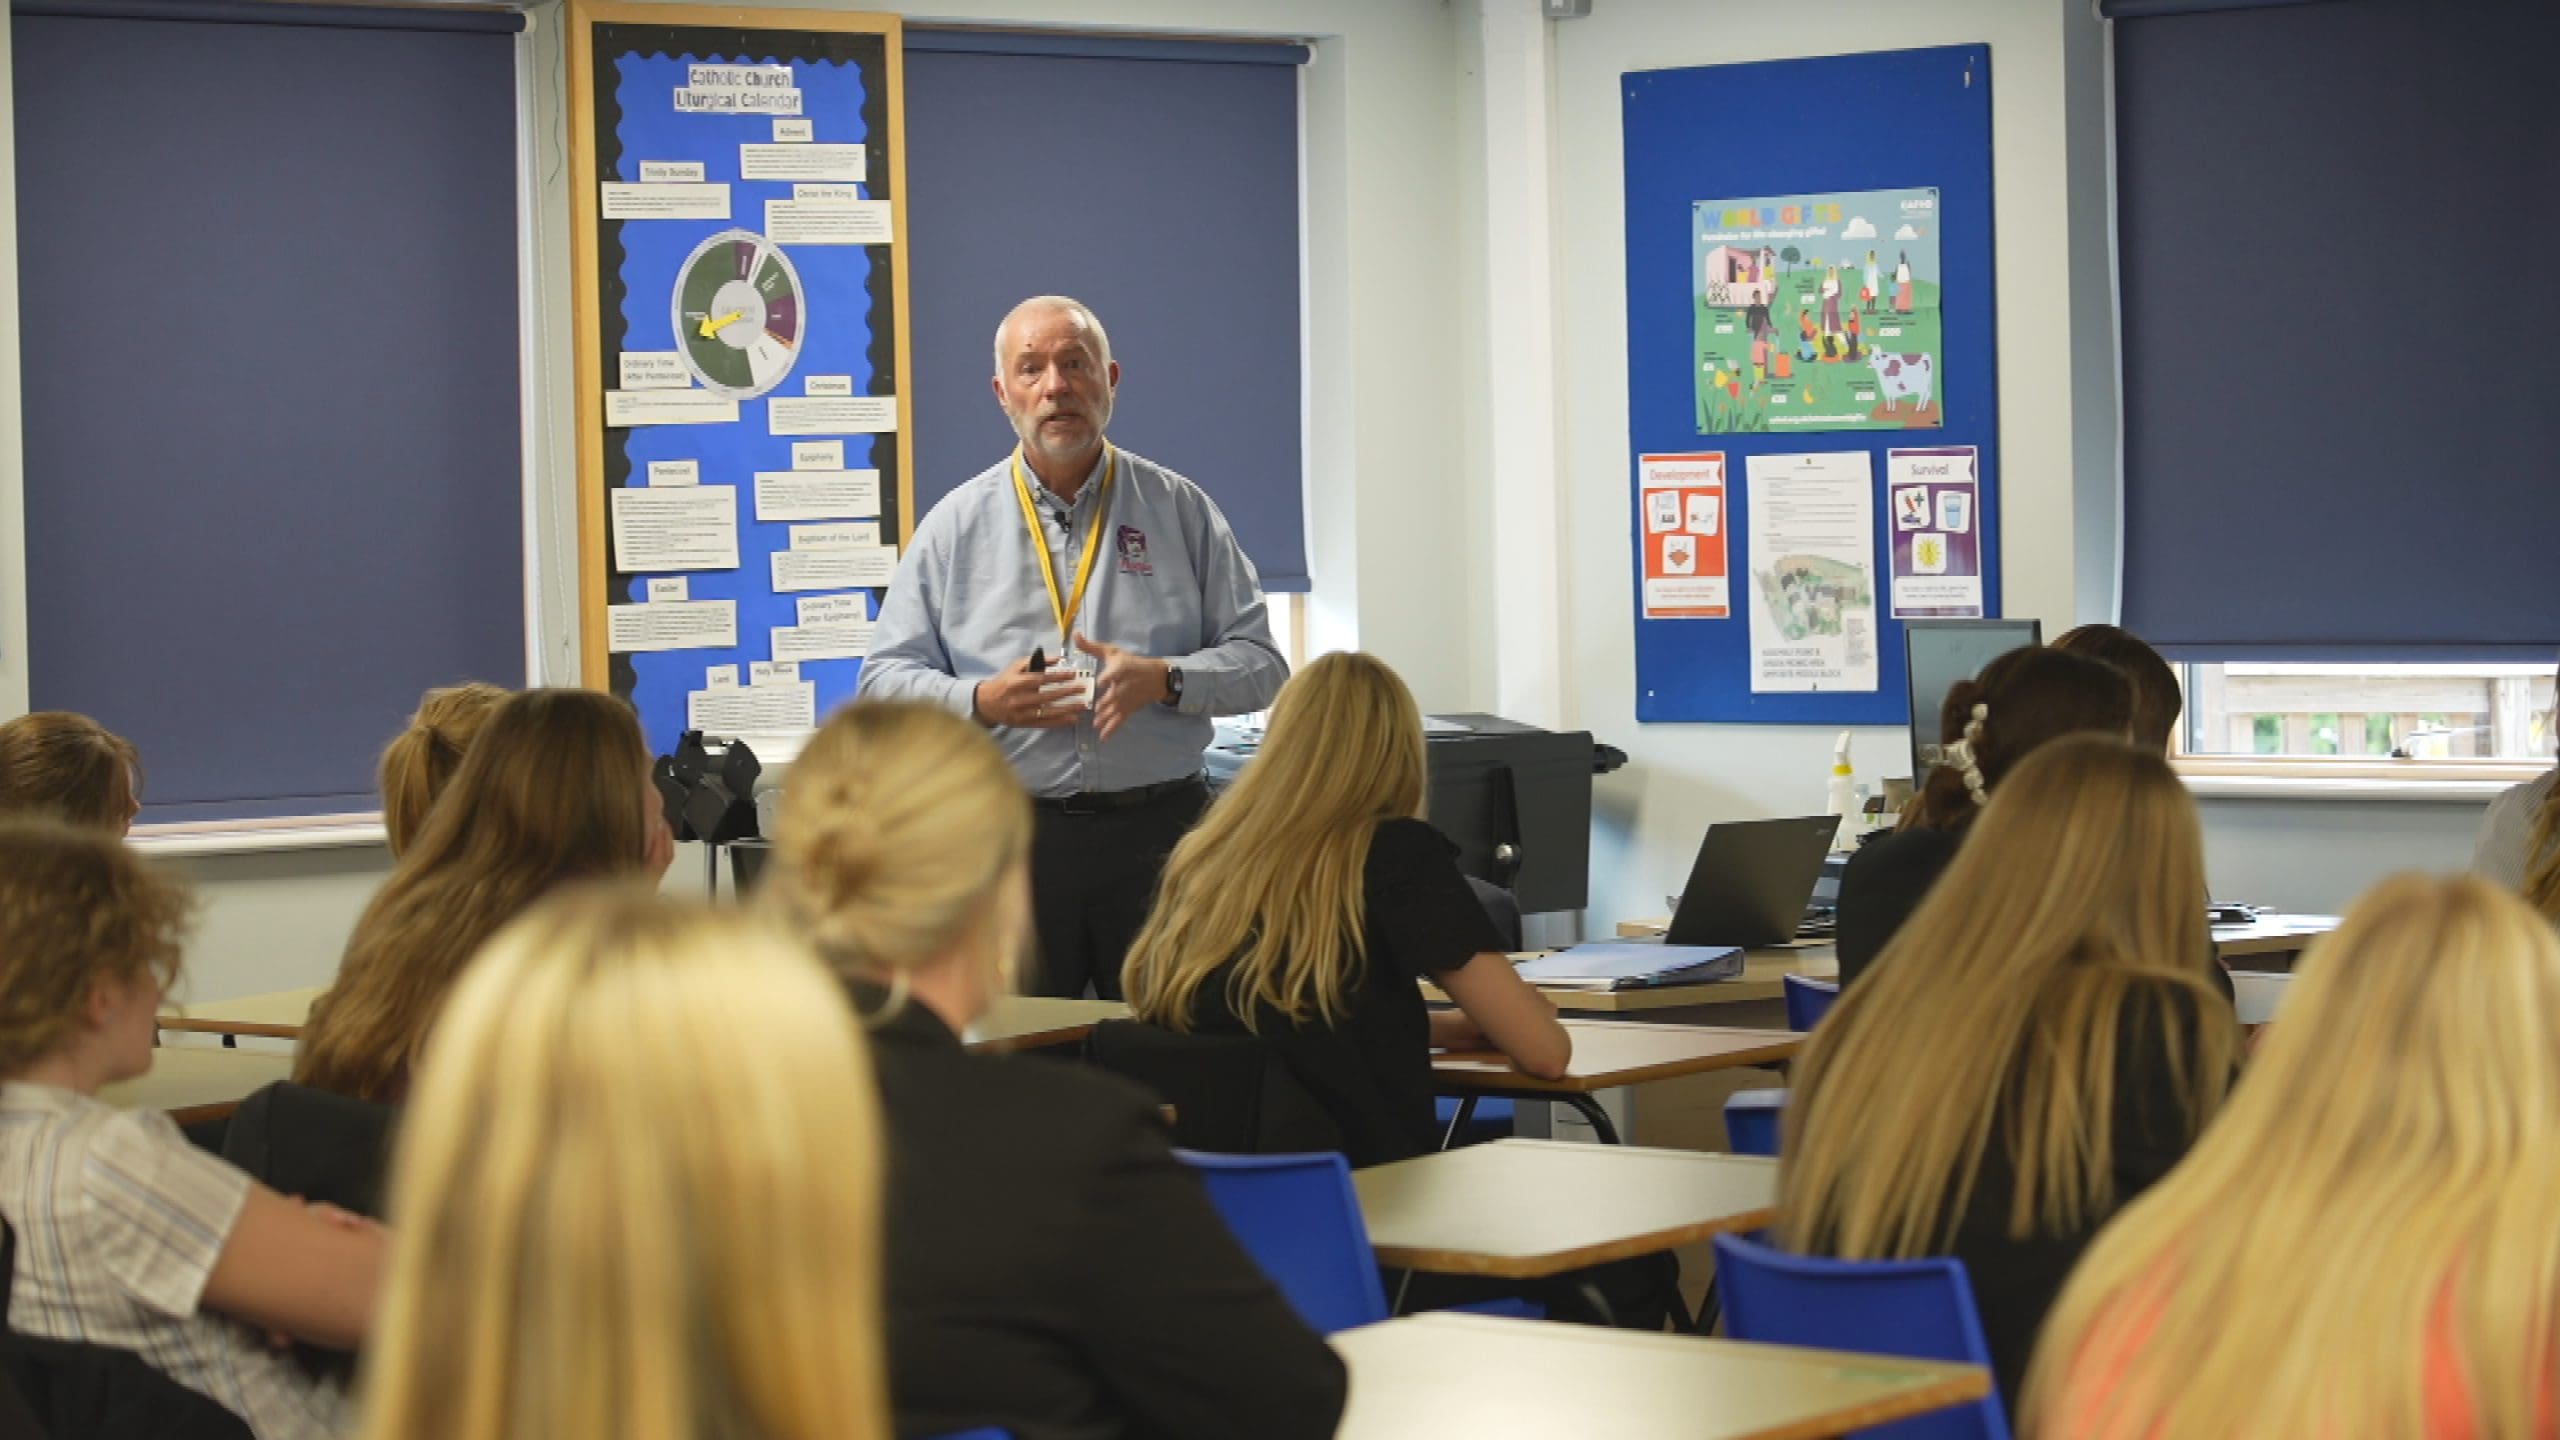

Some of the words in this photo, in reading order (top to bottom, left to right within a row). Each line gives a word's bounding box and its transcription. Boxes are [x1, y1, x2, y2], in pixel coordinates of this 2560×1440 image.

[691, 69, 741, 86] Catholic
[745, 71, 790, 87] Church
[676, 91, 737, 109] Liturgical
[741, 93, 799, 109] Calendar
[644, 167, 667, 178] Trinity
[669, 168, 699, 178] Sunday
[821, 190, 832, 198] the
[834, 190, 852, 199] King
[1702, 207, 1776, 229] WORLD
[1780, 203, 1842, 225] GIFTS
[623, 359, 654, 369] Ordinary
[657, 359, 675, 367] Time
[799, 453, 834, 463] Epiphany
[1649, 468, 1711, 482] Development
[1911, 463, 1950, 476] Survival
[798, 534, 827, 545] Baptism
[828, 533, 837, 542] of
[838, 533, 850, 542] the
[852, 532, 870, 542] Lord
[654, 583, 679, 592] Easter
[802, 602, 832, 612] Ordinary
[833, 599, 852, 607] Time
[755, 667, 771, 677] Holy
[713, 675, 730, 684] Lent
